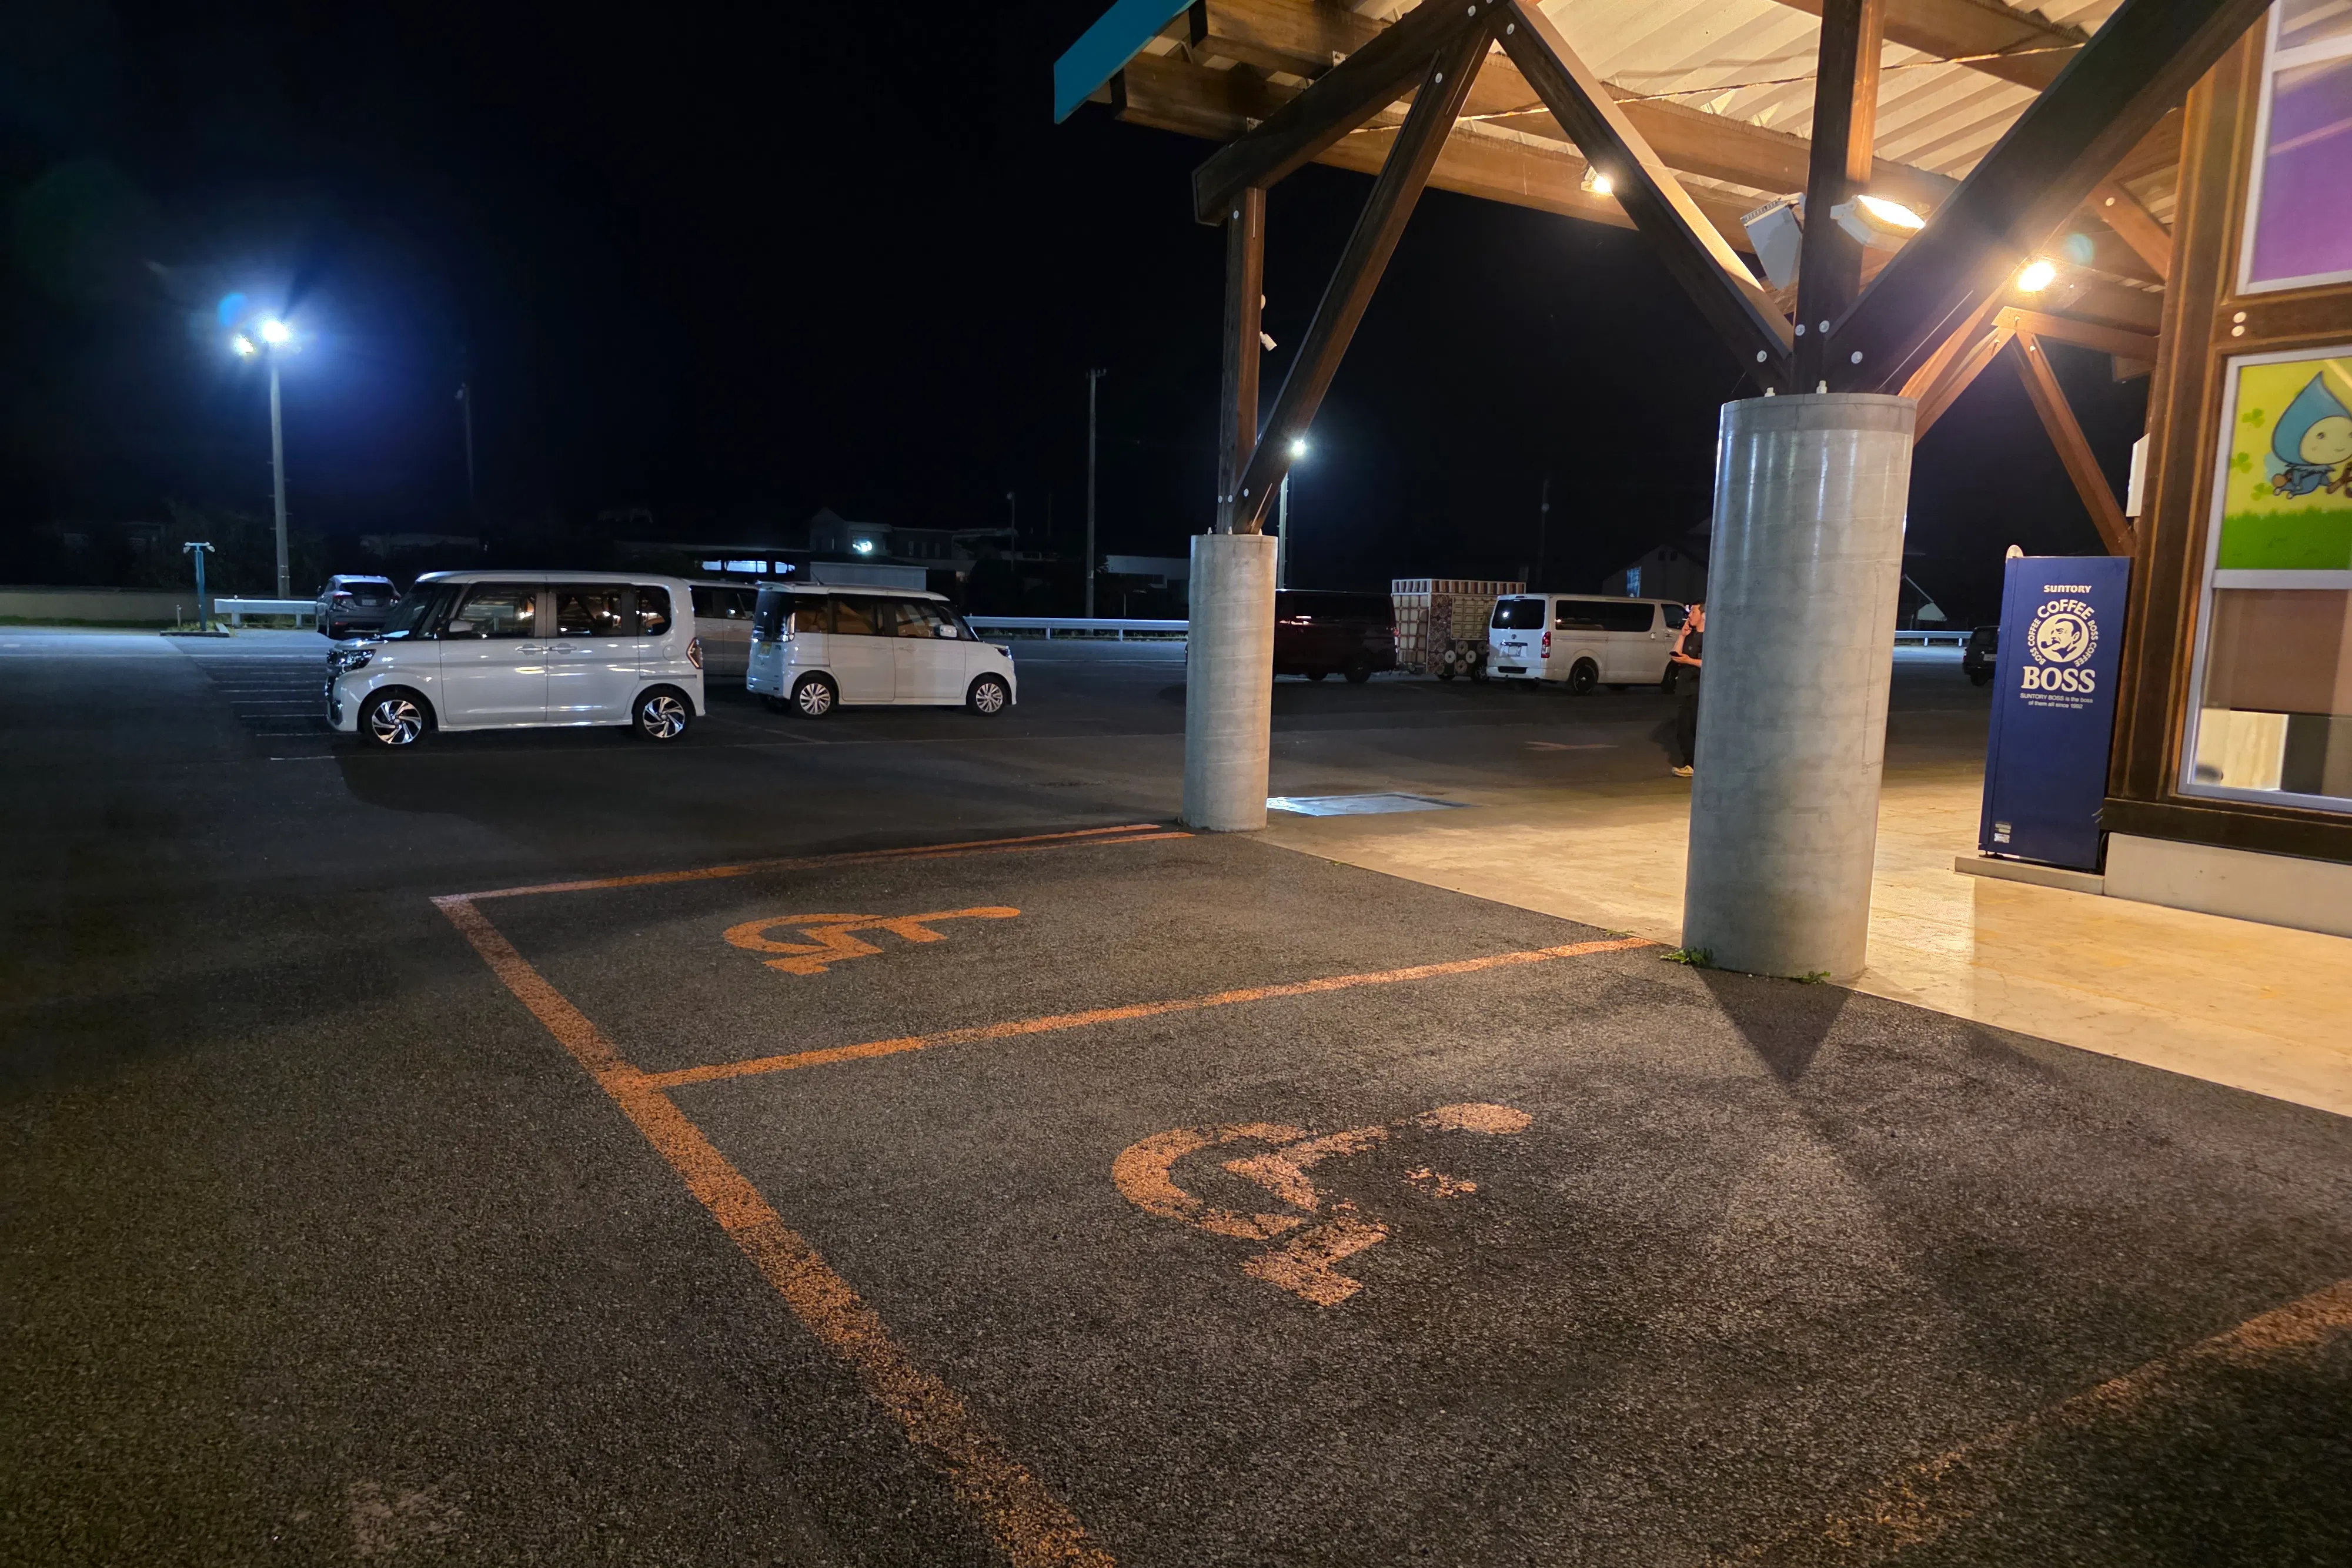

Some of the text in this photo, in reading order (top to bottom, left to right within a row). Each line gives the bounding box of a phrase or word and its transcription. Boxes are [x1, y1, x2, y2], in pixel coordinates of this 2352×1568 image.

[2043, 584, 2092, 593] SUNTORY
[2037, 599, 2094, 620] COFFEE
[2027, 618, 2046, 665] BOSS COFFEE
[2073, 620, 2099, 667] BOSS COFFEE
[2020, 666, 2096, 694] BOSS
